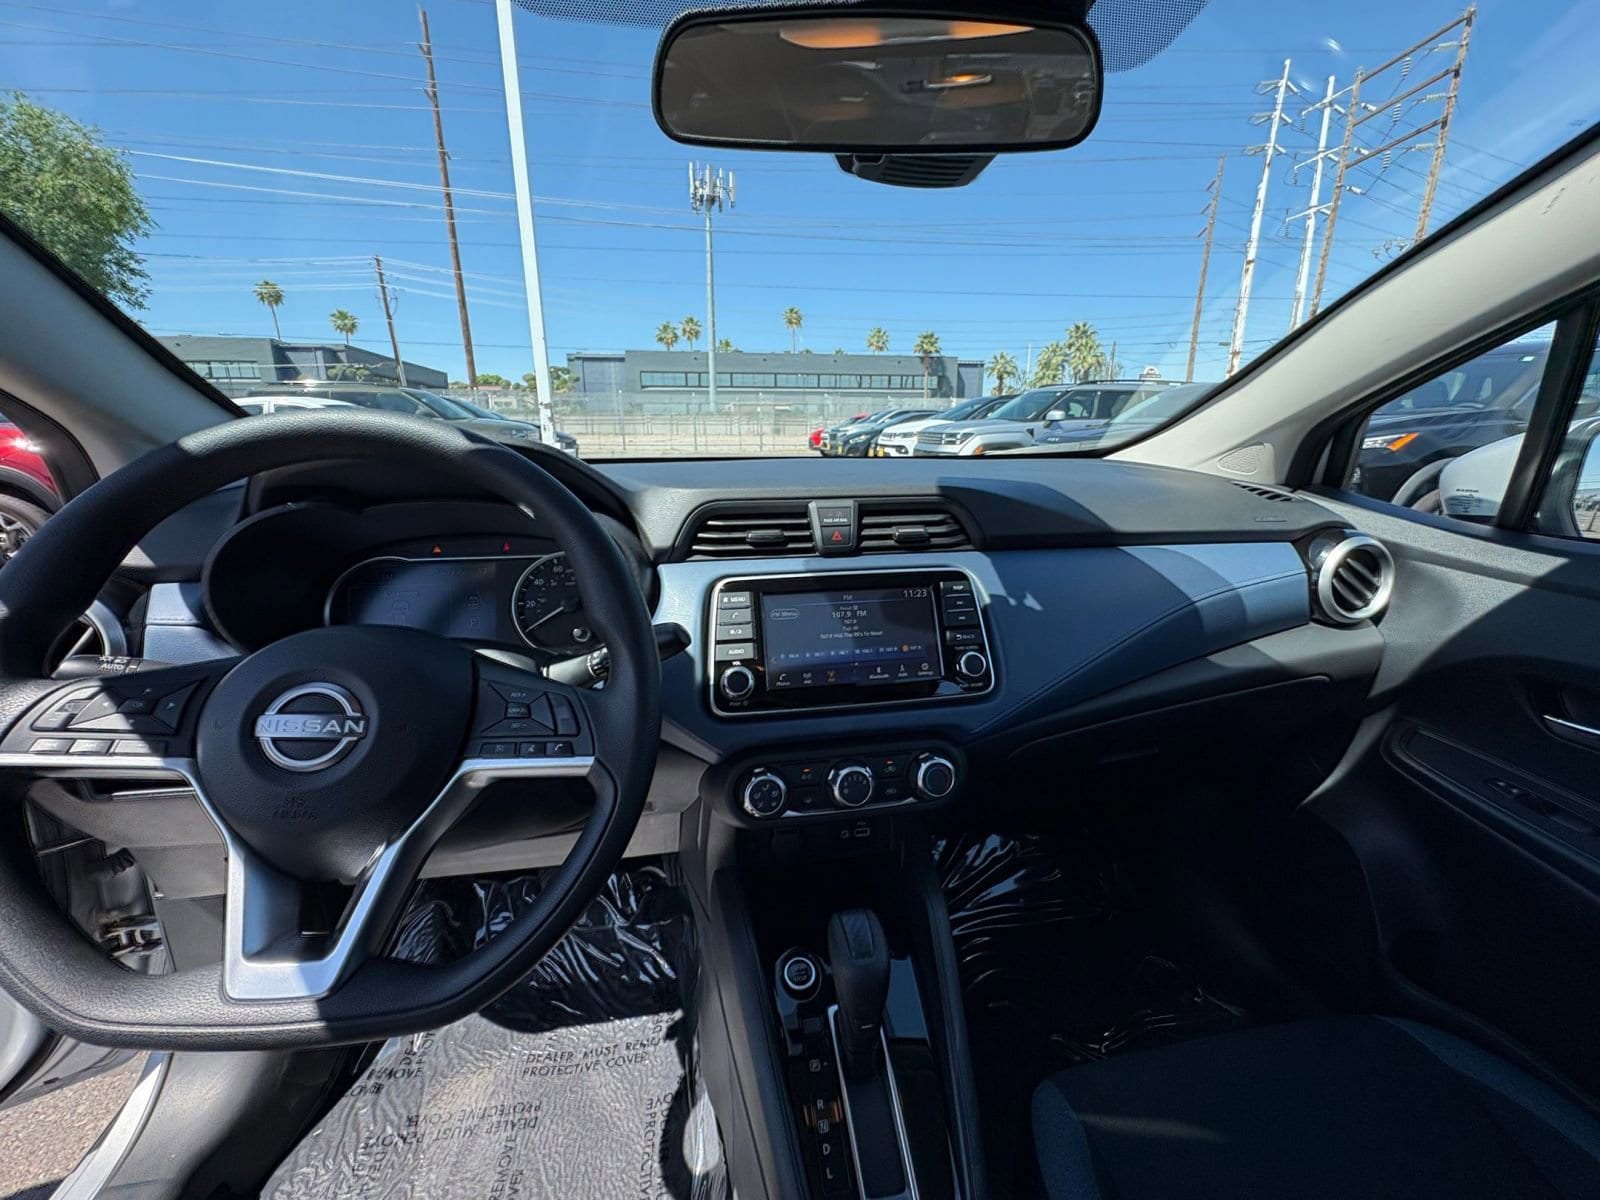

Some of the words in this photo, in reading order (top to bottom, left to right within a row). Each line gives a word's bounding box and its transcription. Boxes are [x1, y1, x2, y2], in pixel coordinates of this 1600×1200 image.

[903, 589, 927, 598] 11:23
[526, 600, 536, 608] 20
[100, 663, 124, 671] AUTO
[260, 719, 365, 734] NISSAN
[526, 1051, 574, 1064] DEALER
[583, 1045, 618, 1059] MUST
[522, 1062, 600, 1078] PROTECTIVE
[606, 1052, 648, 1067] COVER
[458, 1101, 541, 1121] PROTECTIVE
[817, 1100, 824, 1109] R
[433, 1122, 478, 1141] MUST
[486, 1116, 538, 1134] DEALER
[640, 1112, 657, 1200] PROTECTIV
[823, 1145, 831, 1155] D
[827, 1169, 833, 1179] L
